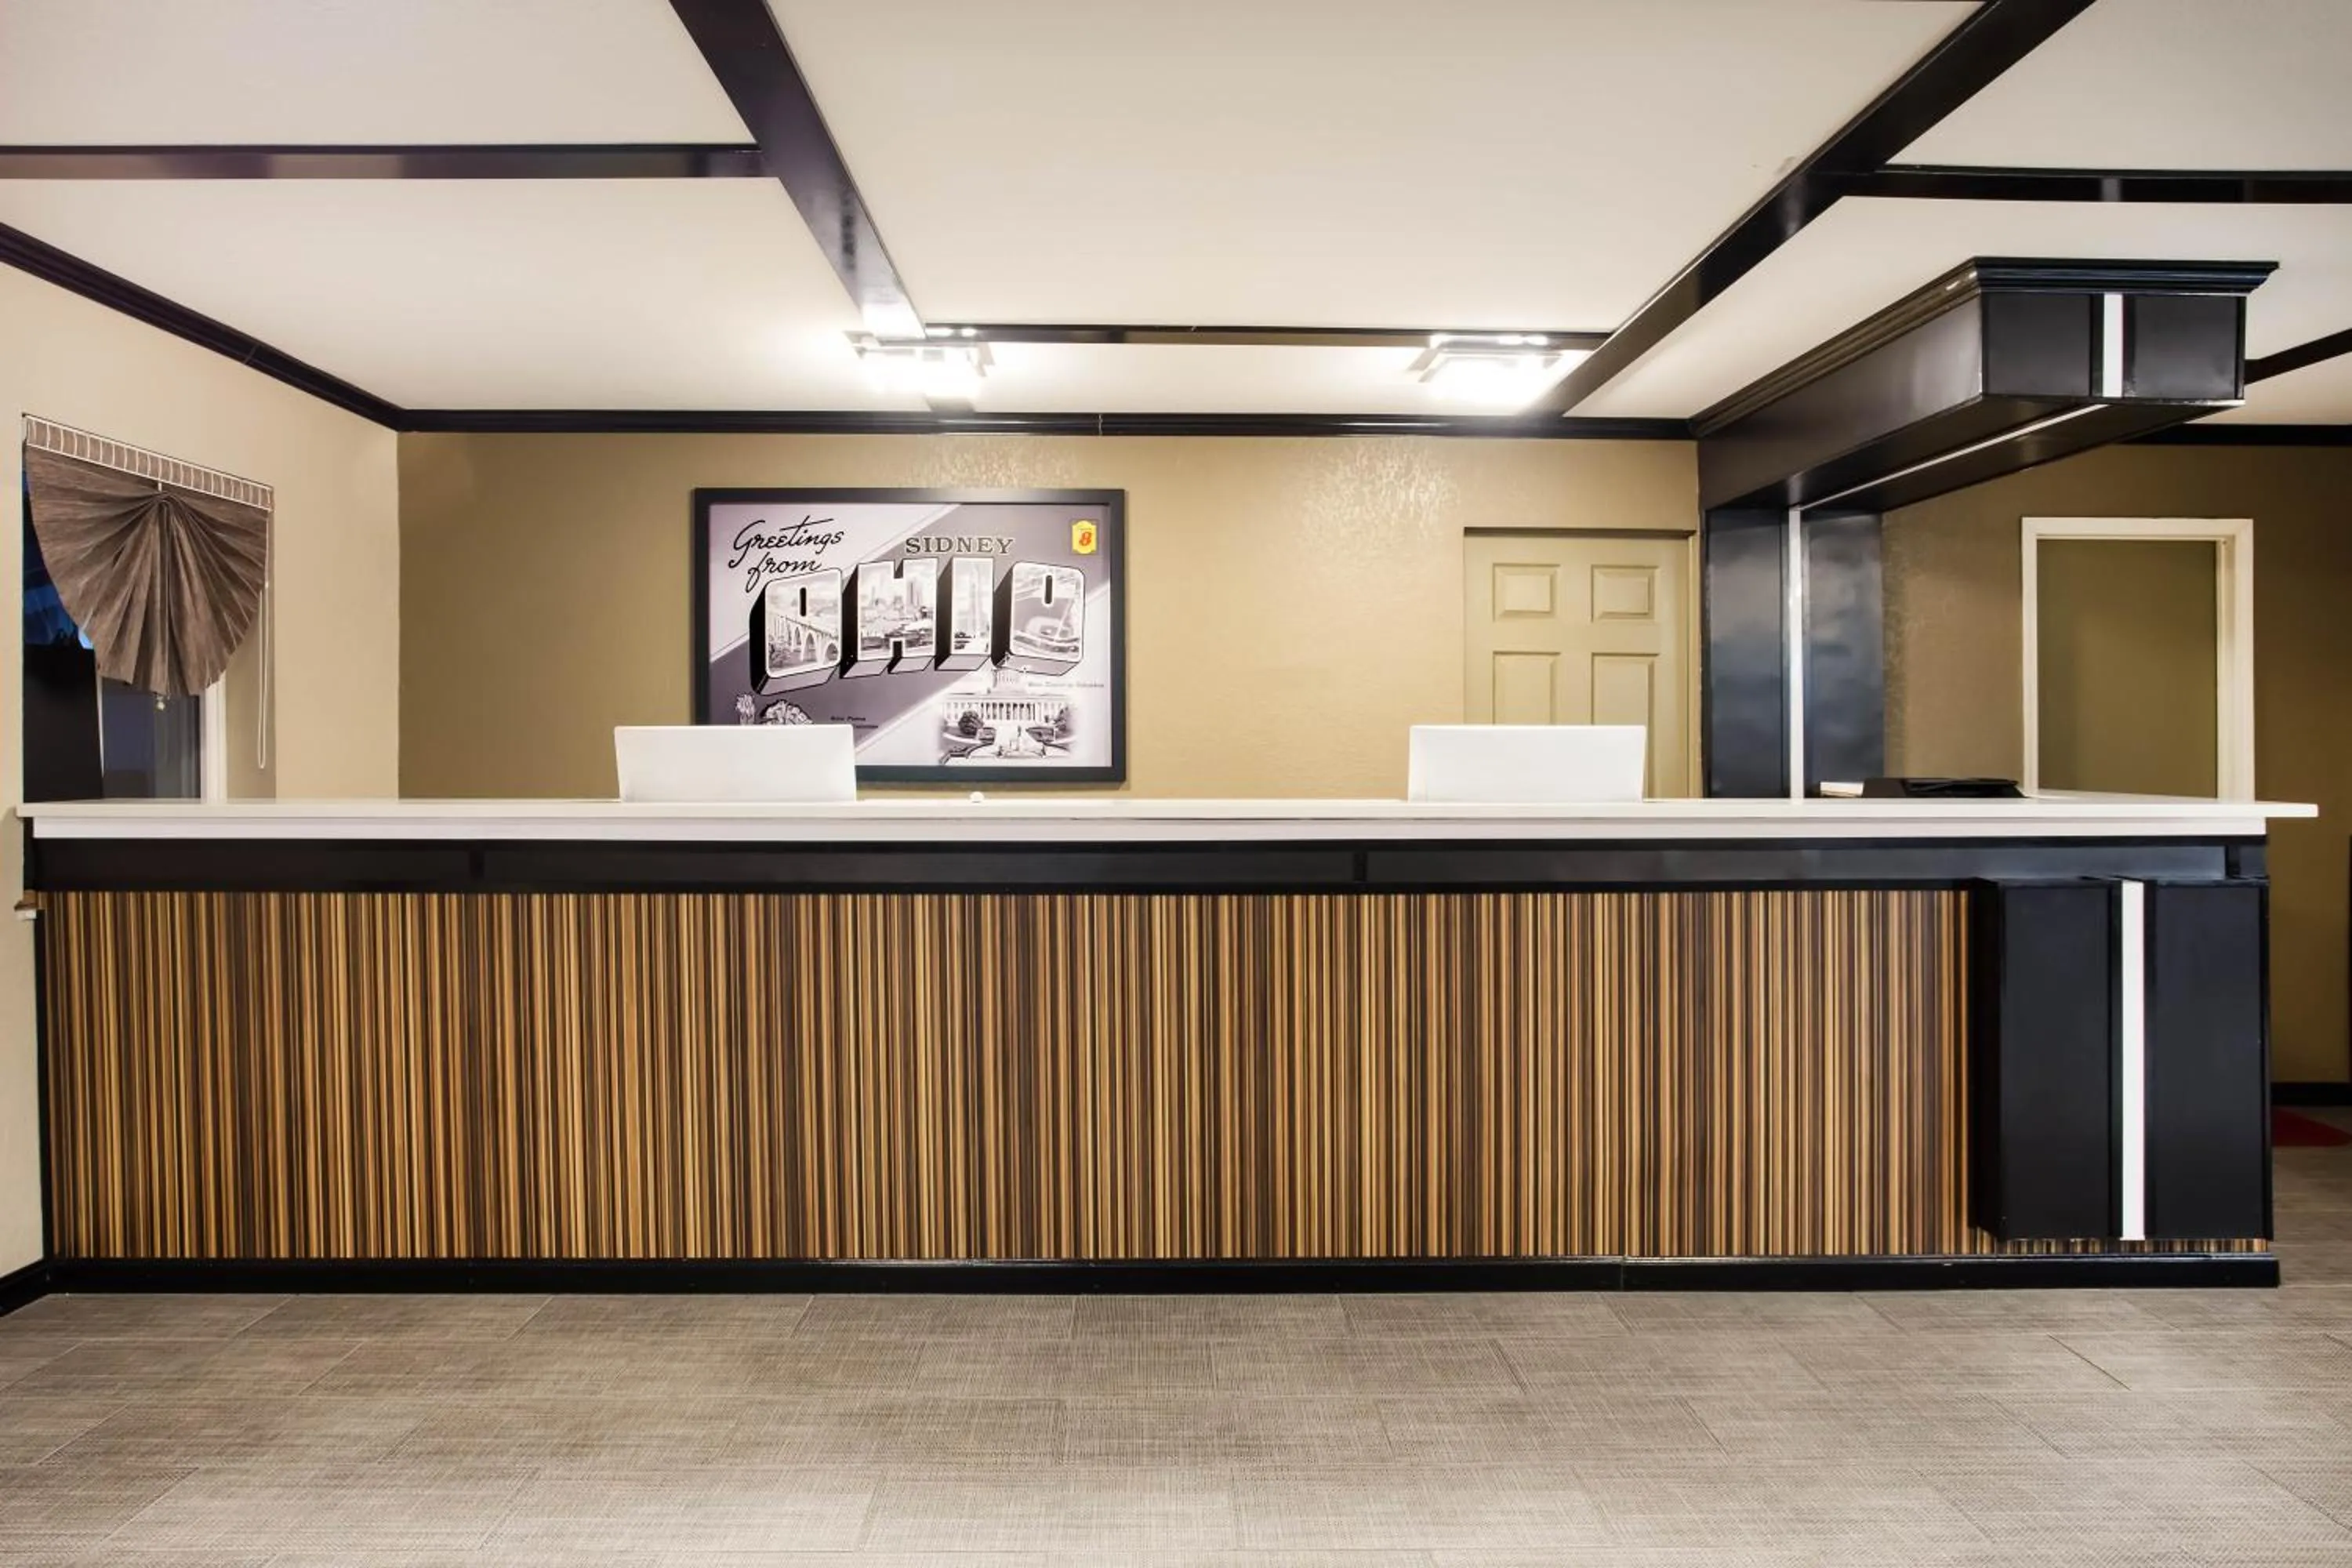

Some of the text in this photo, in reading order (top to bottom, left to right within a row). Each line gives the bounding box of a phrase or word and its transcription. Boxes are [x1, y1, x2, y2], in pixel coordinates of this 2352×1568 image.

[728, 514, 844, 568] Greetings
[905, 536, 1014, 555] SIDNEY
[1078, 532, 1092, 546] 8
[746, 551, 822, 593] from
[750, 557, 1087, 695] OHIO
